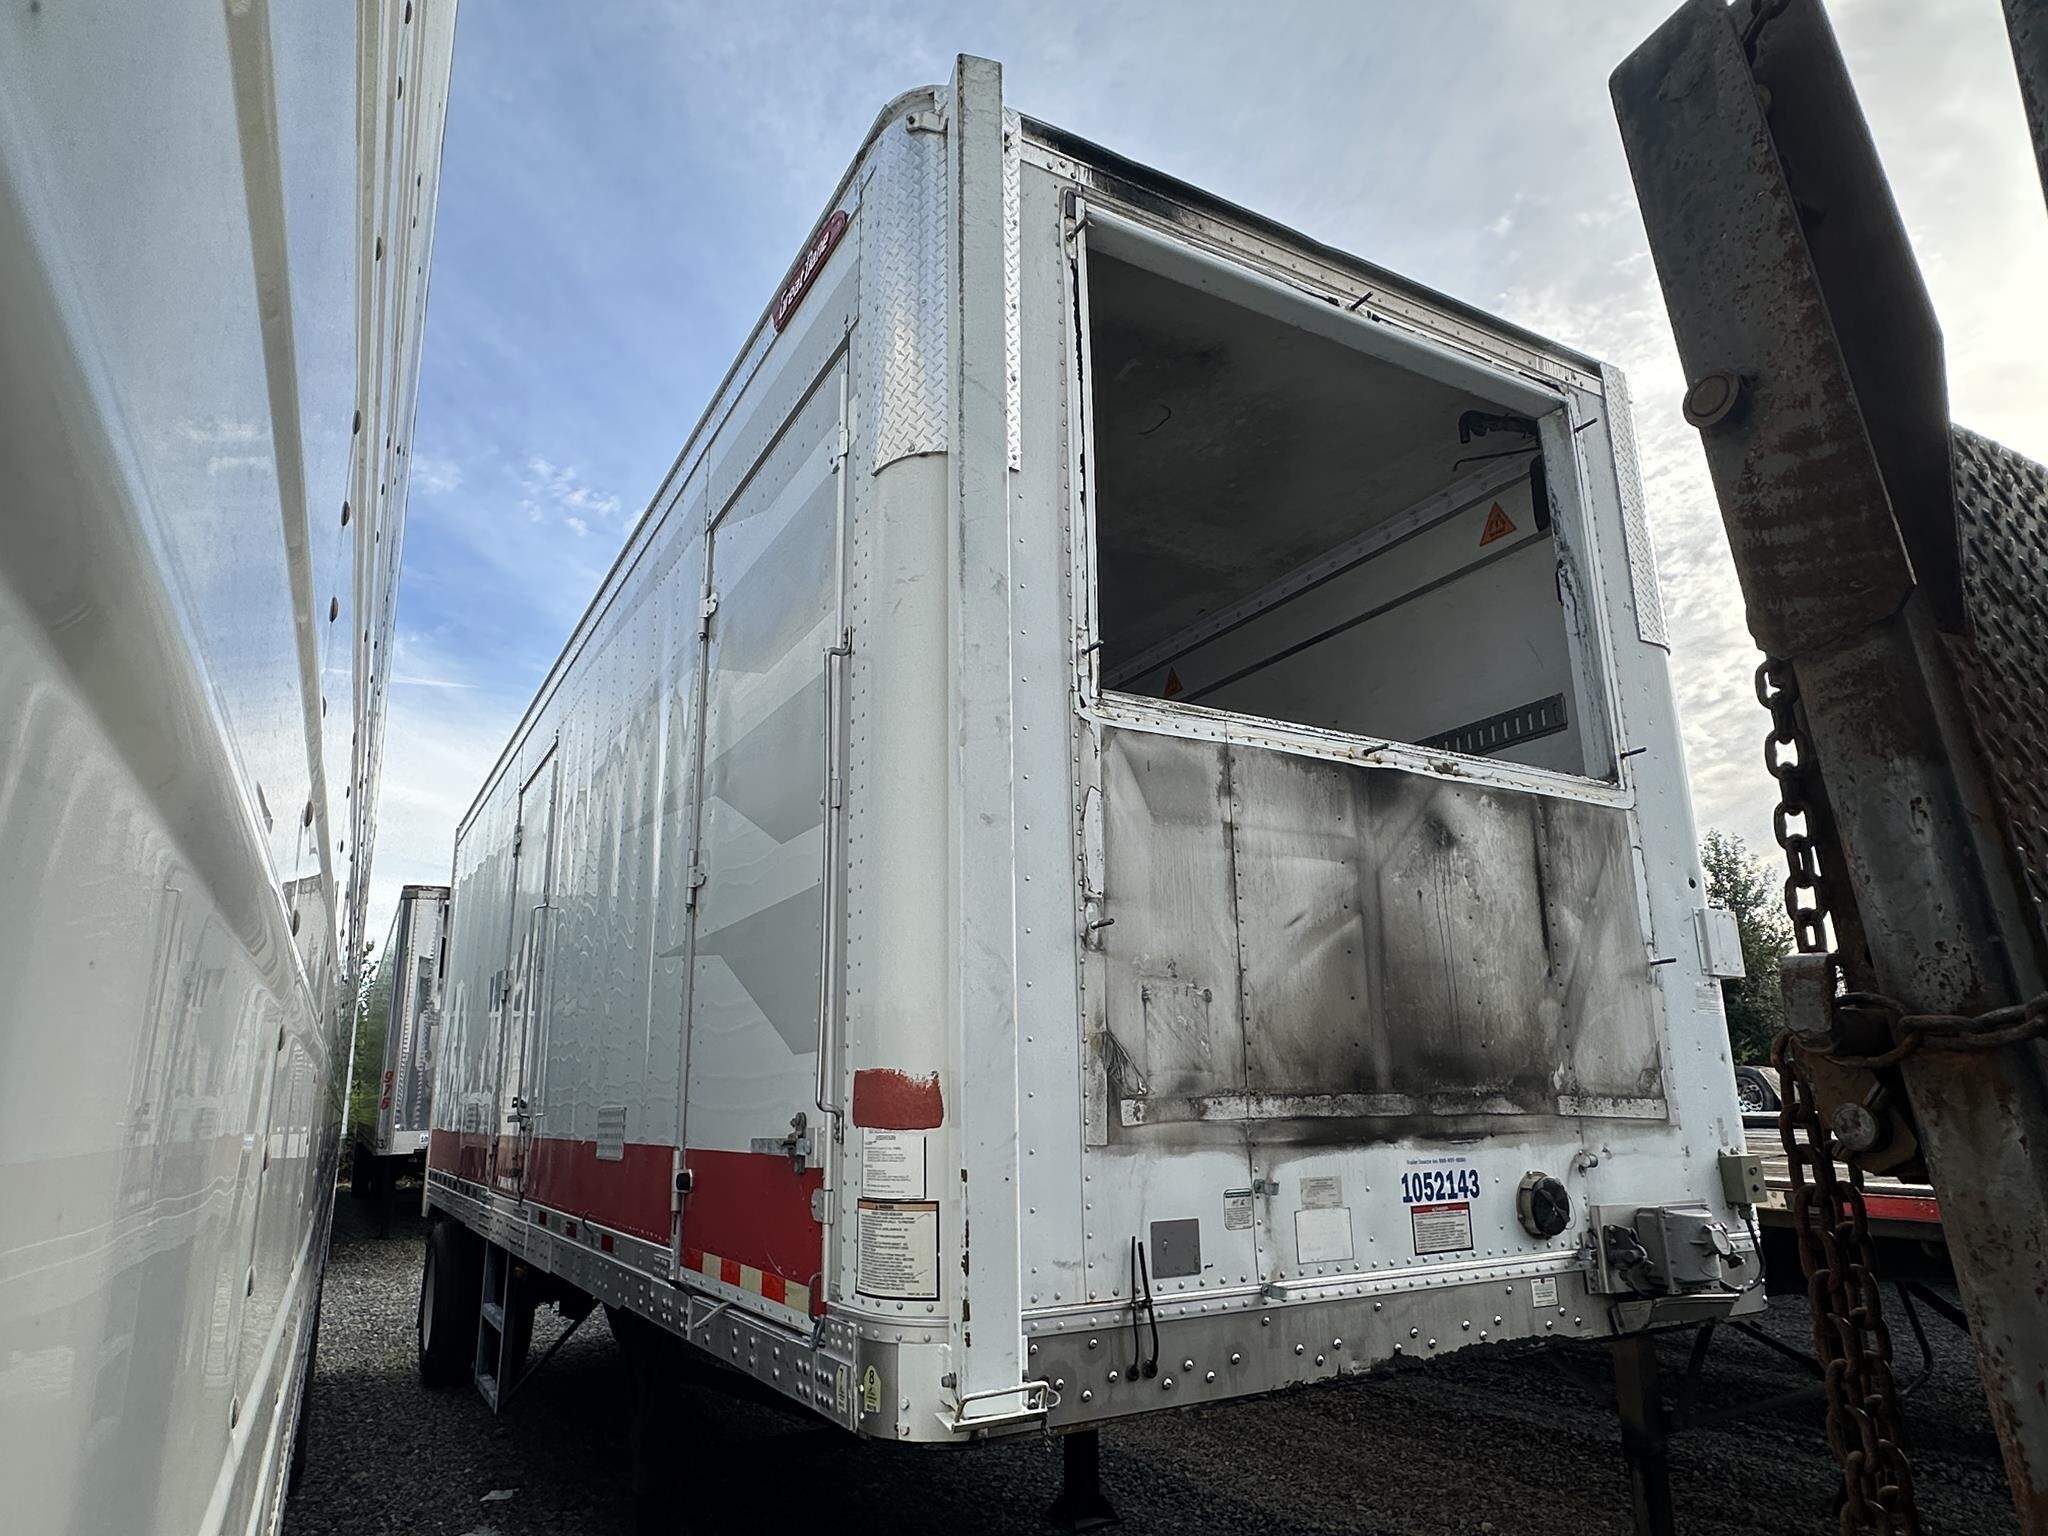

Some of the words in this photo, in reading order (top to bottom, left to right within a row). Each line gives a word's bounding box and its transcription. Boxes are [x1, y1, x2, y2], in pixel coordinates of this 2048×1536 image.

[778, 268, 805, 321] Great
[1401, 1169, 1480, 1203] 1052143
[868, 1369, 875, 1385] 8
